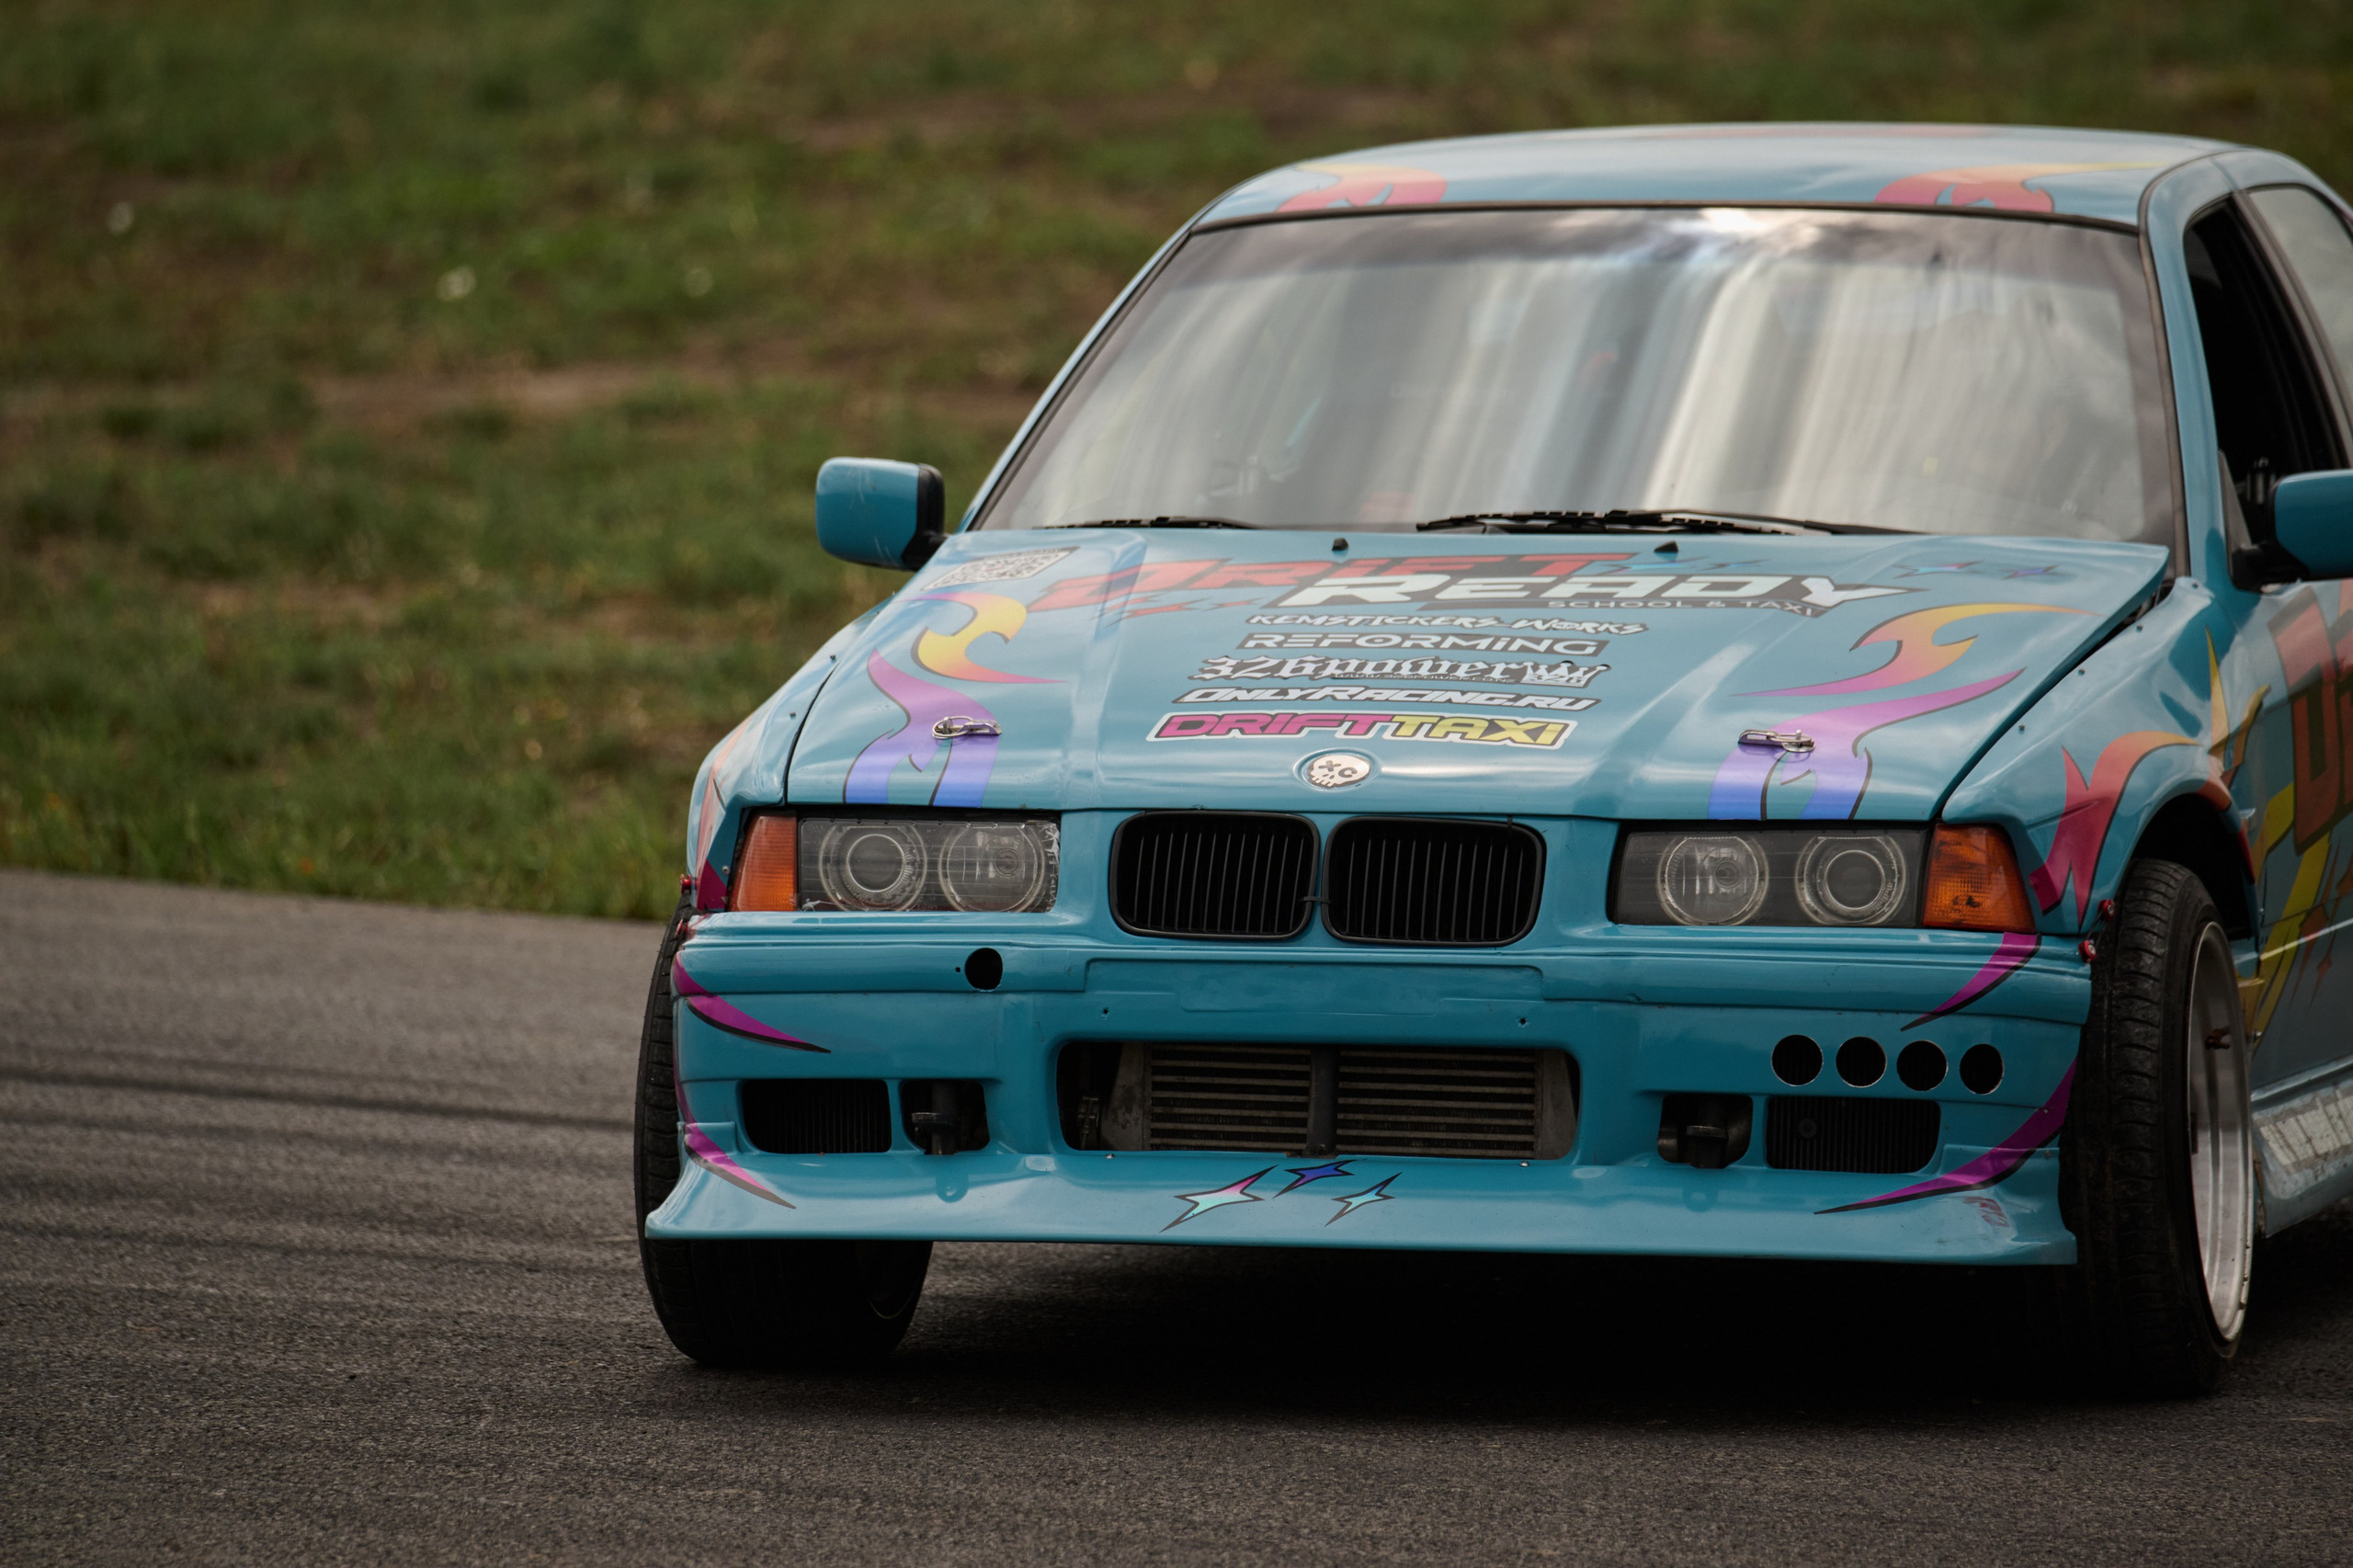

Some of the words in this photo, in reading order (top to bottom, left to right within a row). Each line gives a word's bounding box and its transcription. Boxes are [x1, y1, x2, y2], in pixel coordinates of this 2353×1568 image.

[1277, 574, 1910, 608] READY
[1547, 600, 1693, 609] SCHOOL
[1705, 600, 1726, 609] &
[1740, 600, 1813, 617] TAXI
